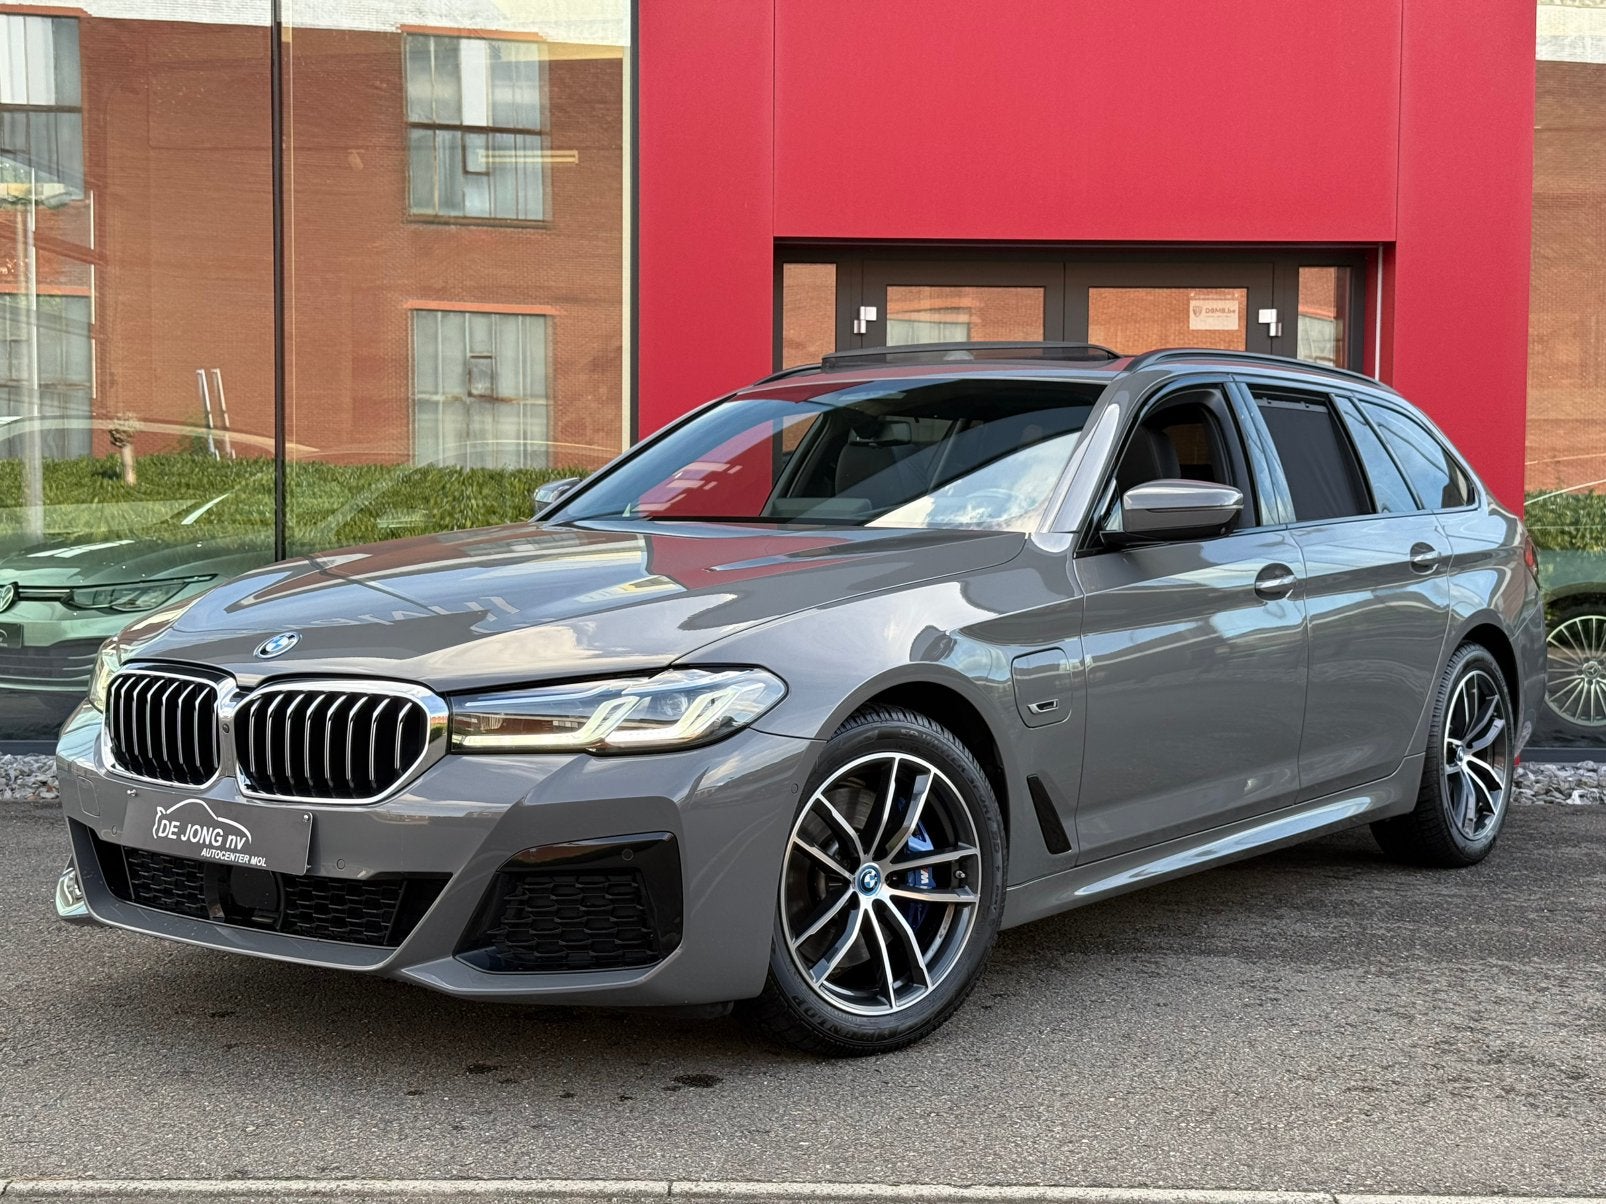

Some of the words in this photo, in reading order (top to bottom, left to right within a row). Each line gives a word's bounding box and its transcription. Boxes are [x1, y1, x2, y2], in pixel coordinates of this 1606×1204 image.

[157, 819, 181, 840] DE
[180, 823, 224, 847] JONG
[225, 834, 247, 850] nv
[200, 847, 250, 864] AUTOCENTER
[249, 855, 267, 867] MOL
